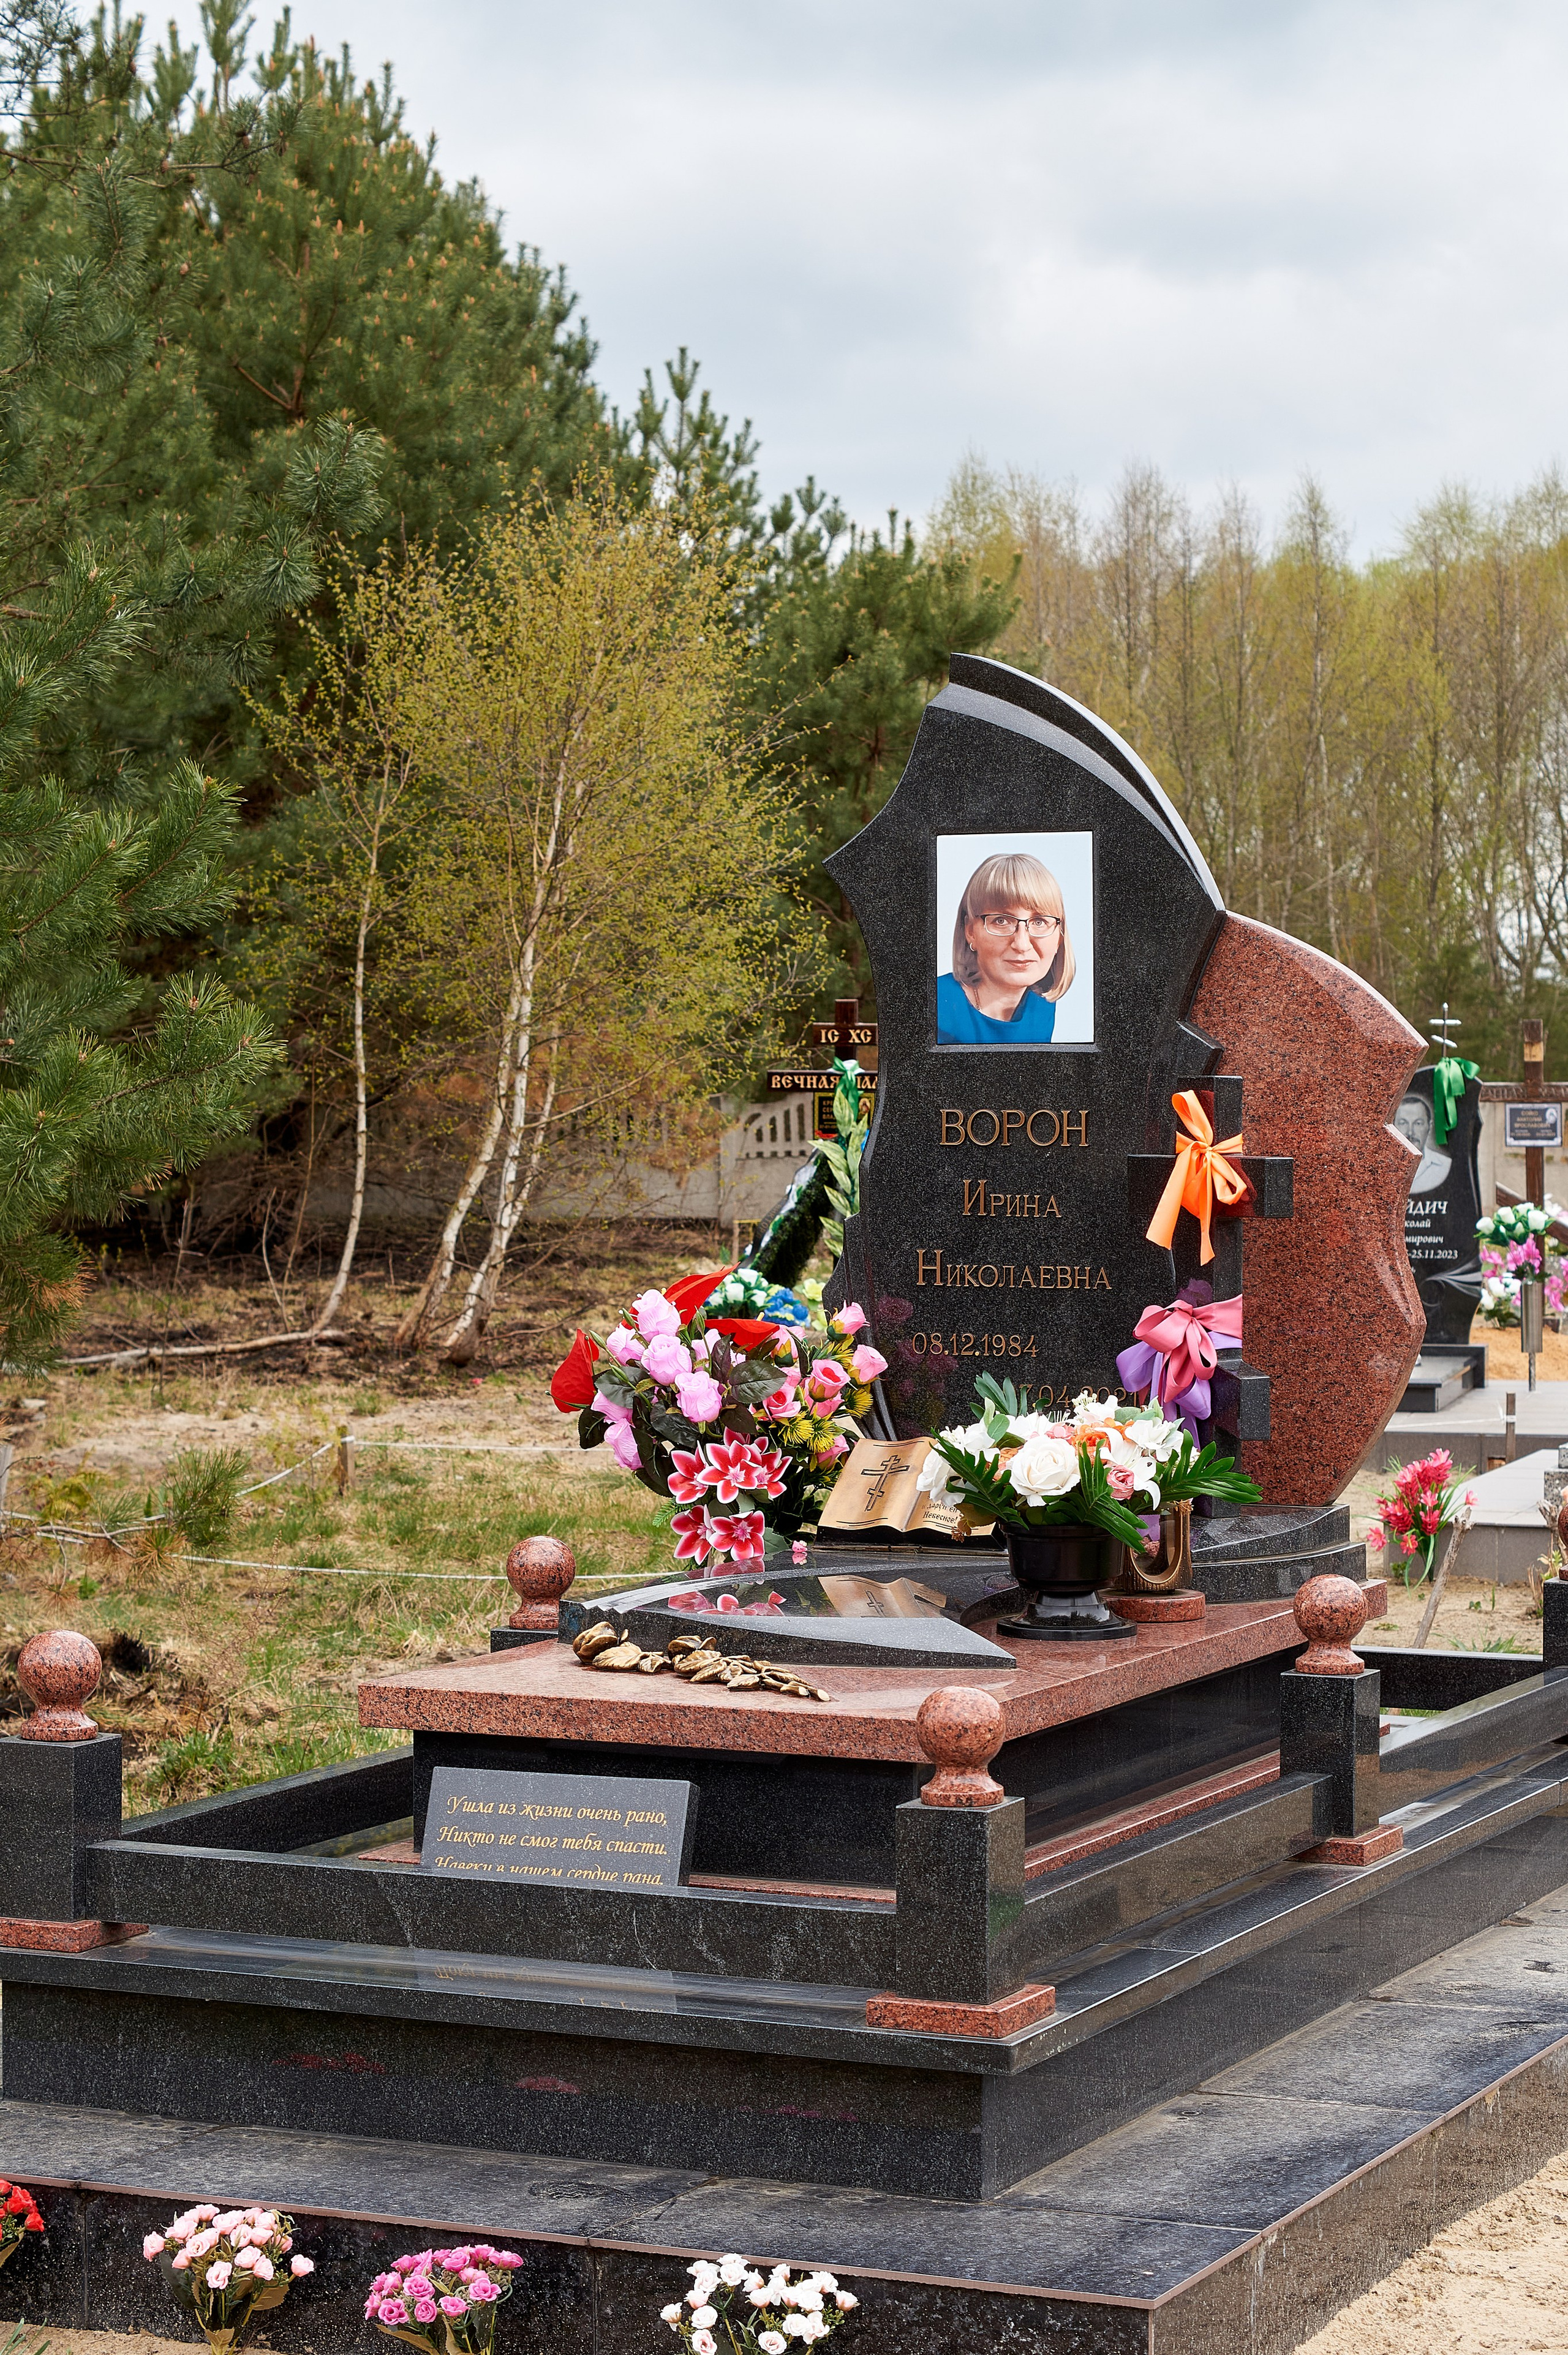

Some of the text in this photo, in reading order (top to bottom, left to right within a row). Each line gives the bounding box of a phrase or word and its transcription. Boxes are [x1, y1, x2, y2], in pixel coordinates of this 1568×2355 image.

[771, 1075, 840, 1089] ВЕЧНАЯ
[939, 1109, 1090, 1147] ВОРОН
[1407, 1249, 1458, 1259] -25.11.2023
[911, 1332, 1039, 1358] 08.12.1984
[1015, 1383, 1137, 1408] 7.04.2021
[447, 1796, 668, 1827] Ушла из жизни очень рано,
[437, 1825, 668, 1855] Никто не смог тебя спасти.
